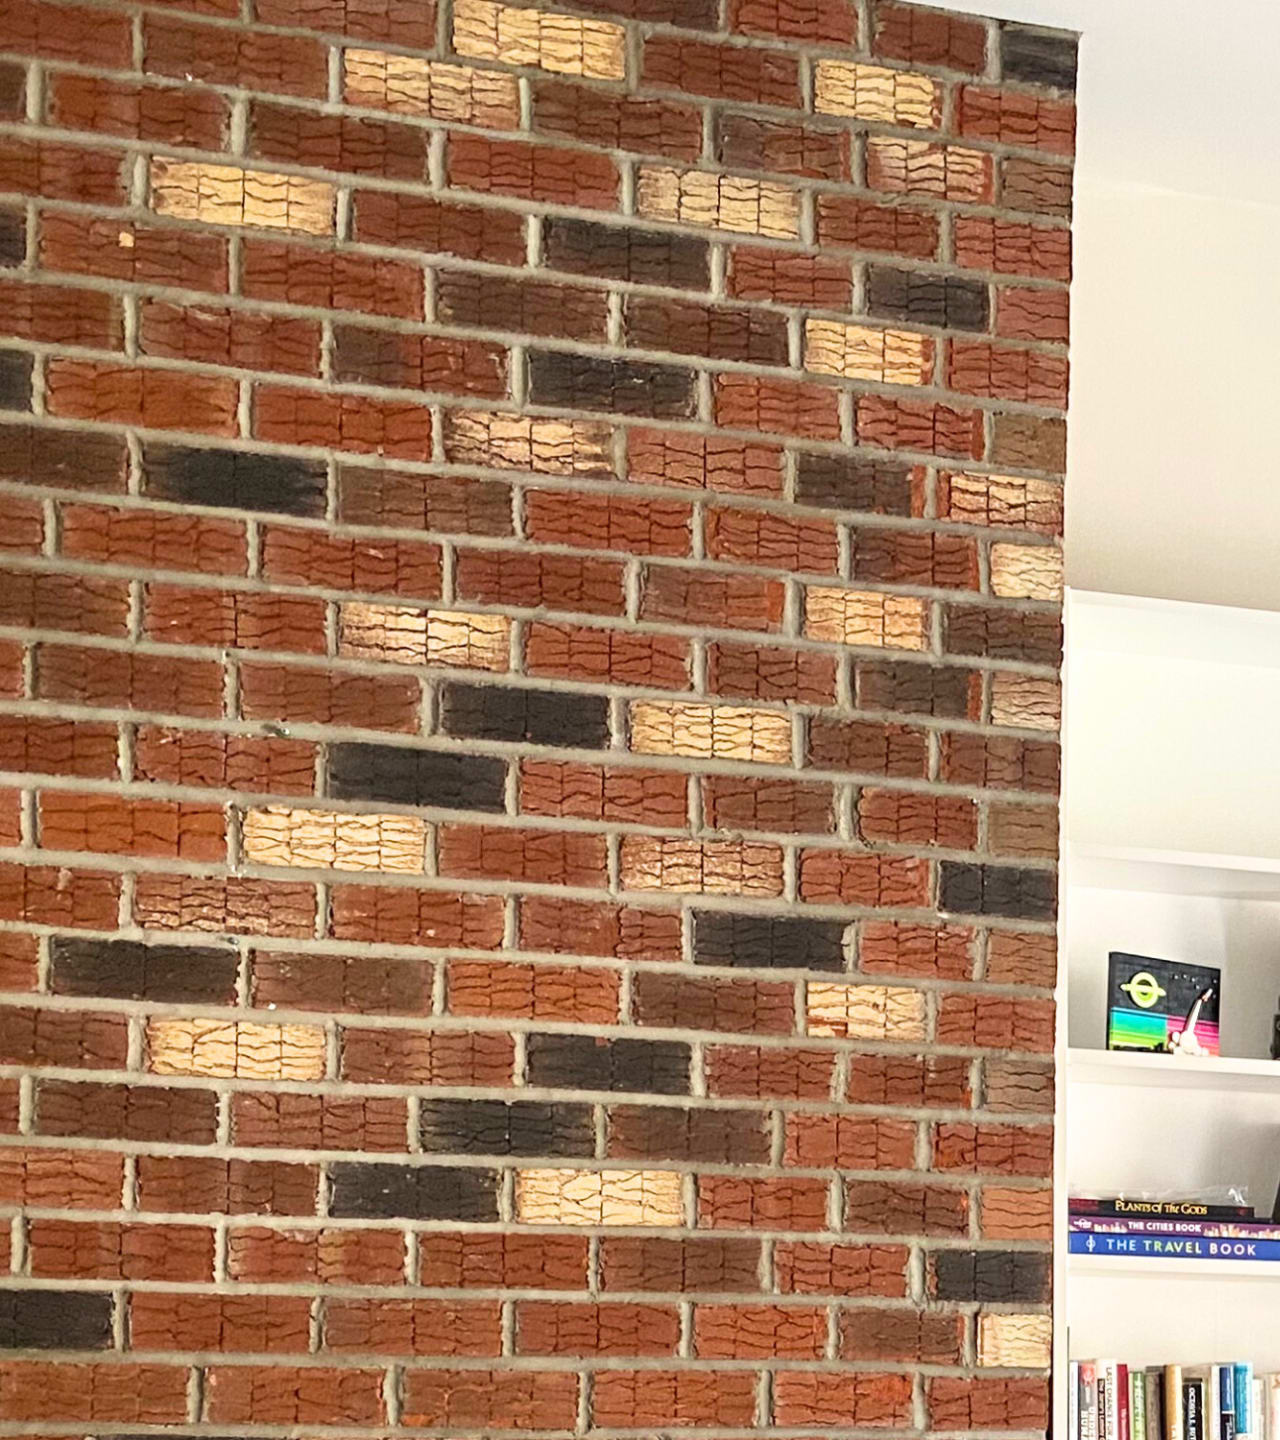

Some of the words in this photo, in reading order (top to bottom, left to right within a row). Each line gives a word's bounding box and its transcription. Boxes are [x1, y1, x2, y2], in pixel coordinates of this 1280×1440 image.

[1128, 1221, 1145, 1230] THE
[1146, 1222, 1174, 1231] CITIES
[1175, 1223, 1202, 1232] BOOK
[1107, 1239, 1136, 1251] THE
[1143, 1240, 1202, 1254] TRAVEL
[1209, 1243, 1257, 1256] BOOK
